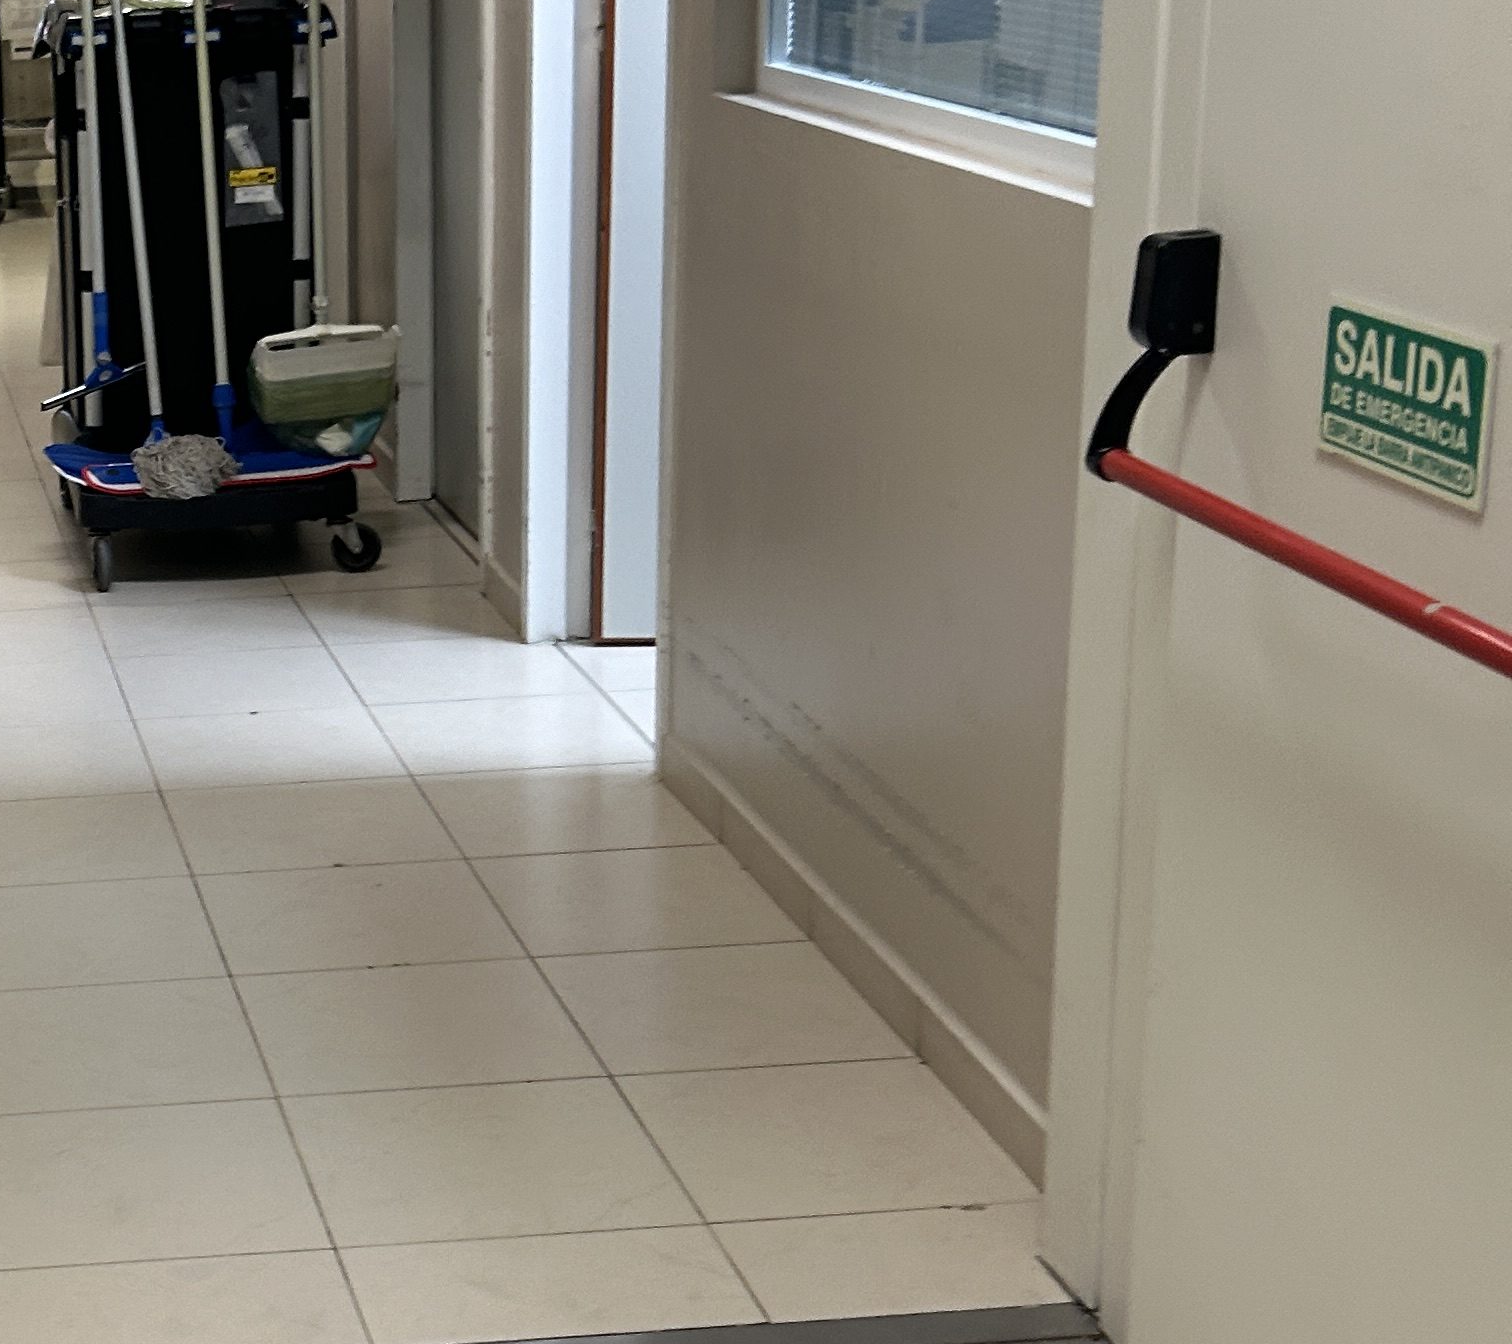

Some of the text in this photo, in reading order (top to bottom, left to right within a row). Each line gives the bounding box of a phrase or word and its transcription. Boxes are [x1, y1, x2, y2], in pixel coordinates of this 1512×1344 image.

[1334, 319, 1471, 419] SALIDA
[1329, 382, 1353, 411] DE
[1356, 391, 1469, 456] EMERGENCIA
